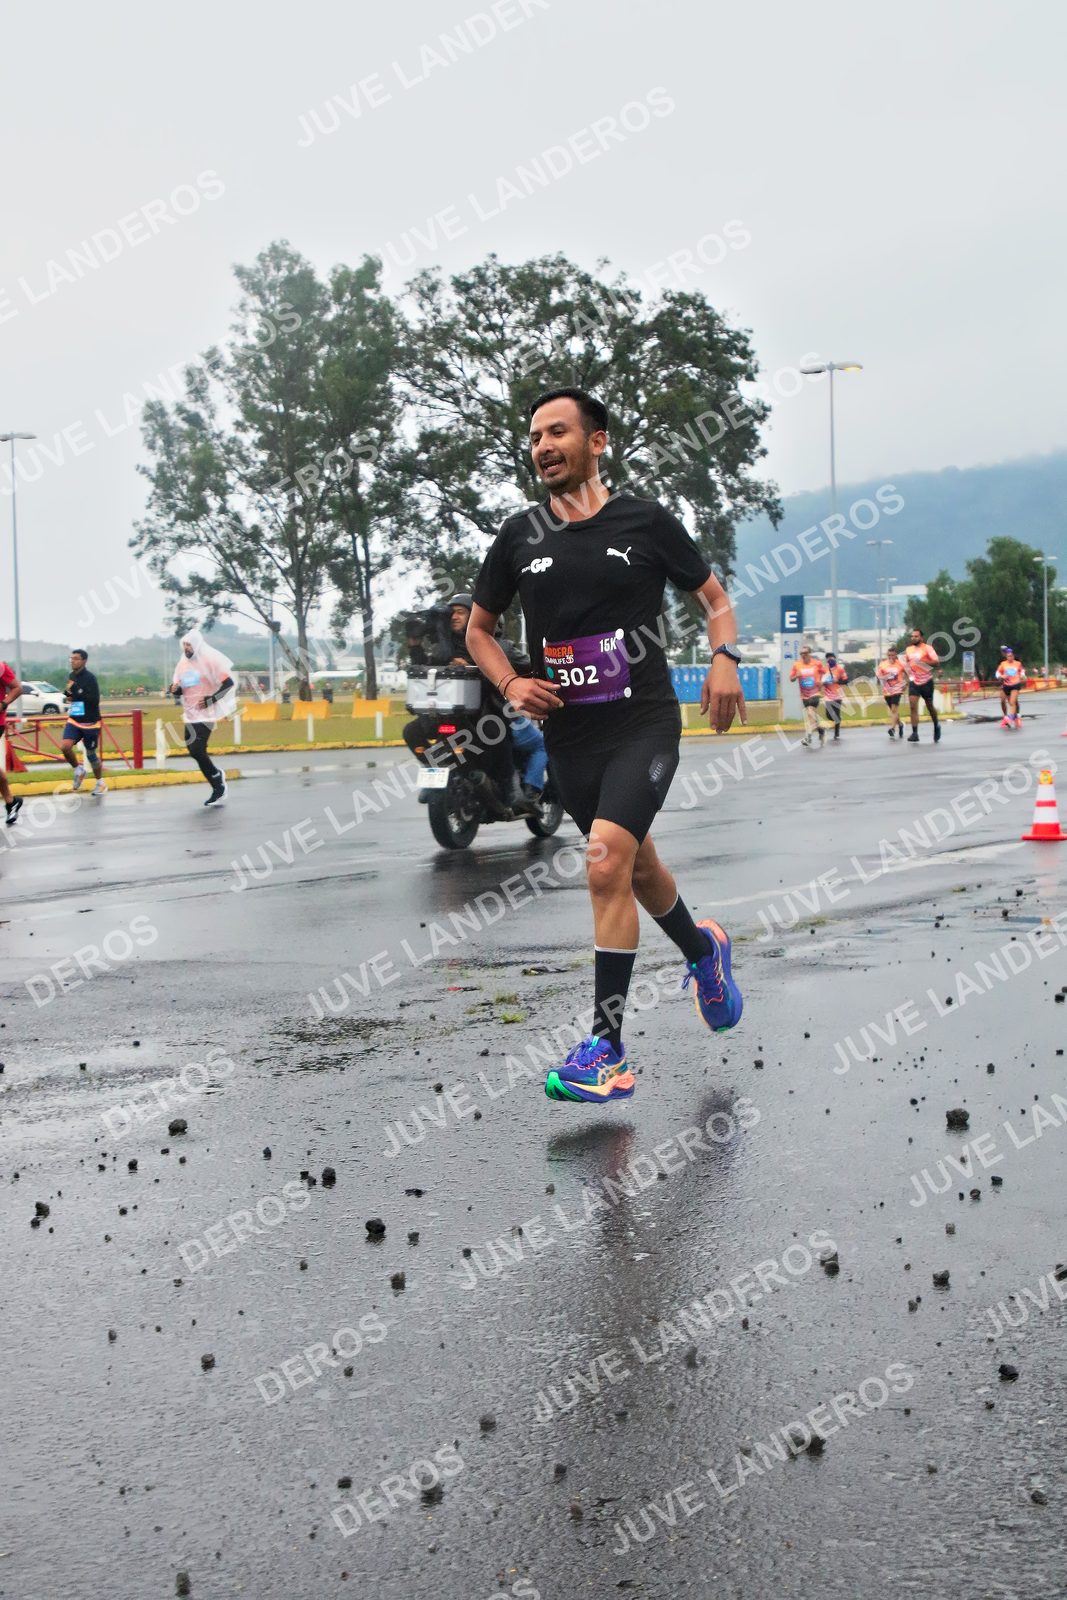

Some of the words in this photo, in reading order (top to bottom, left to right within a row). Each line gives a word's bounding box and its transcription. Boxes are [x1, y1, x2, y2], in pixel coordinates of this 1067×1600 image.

[530, 557, 553, 573] GP
[784, 611, 798, 628] E
[558, 665, 599, 686] 302
